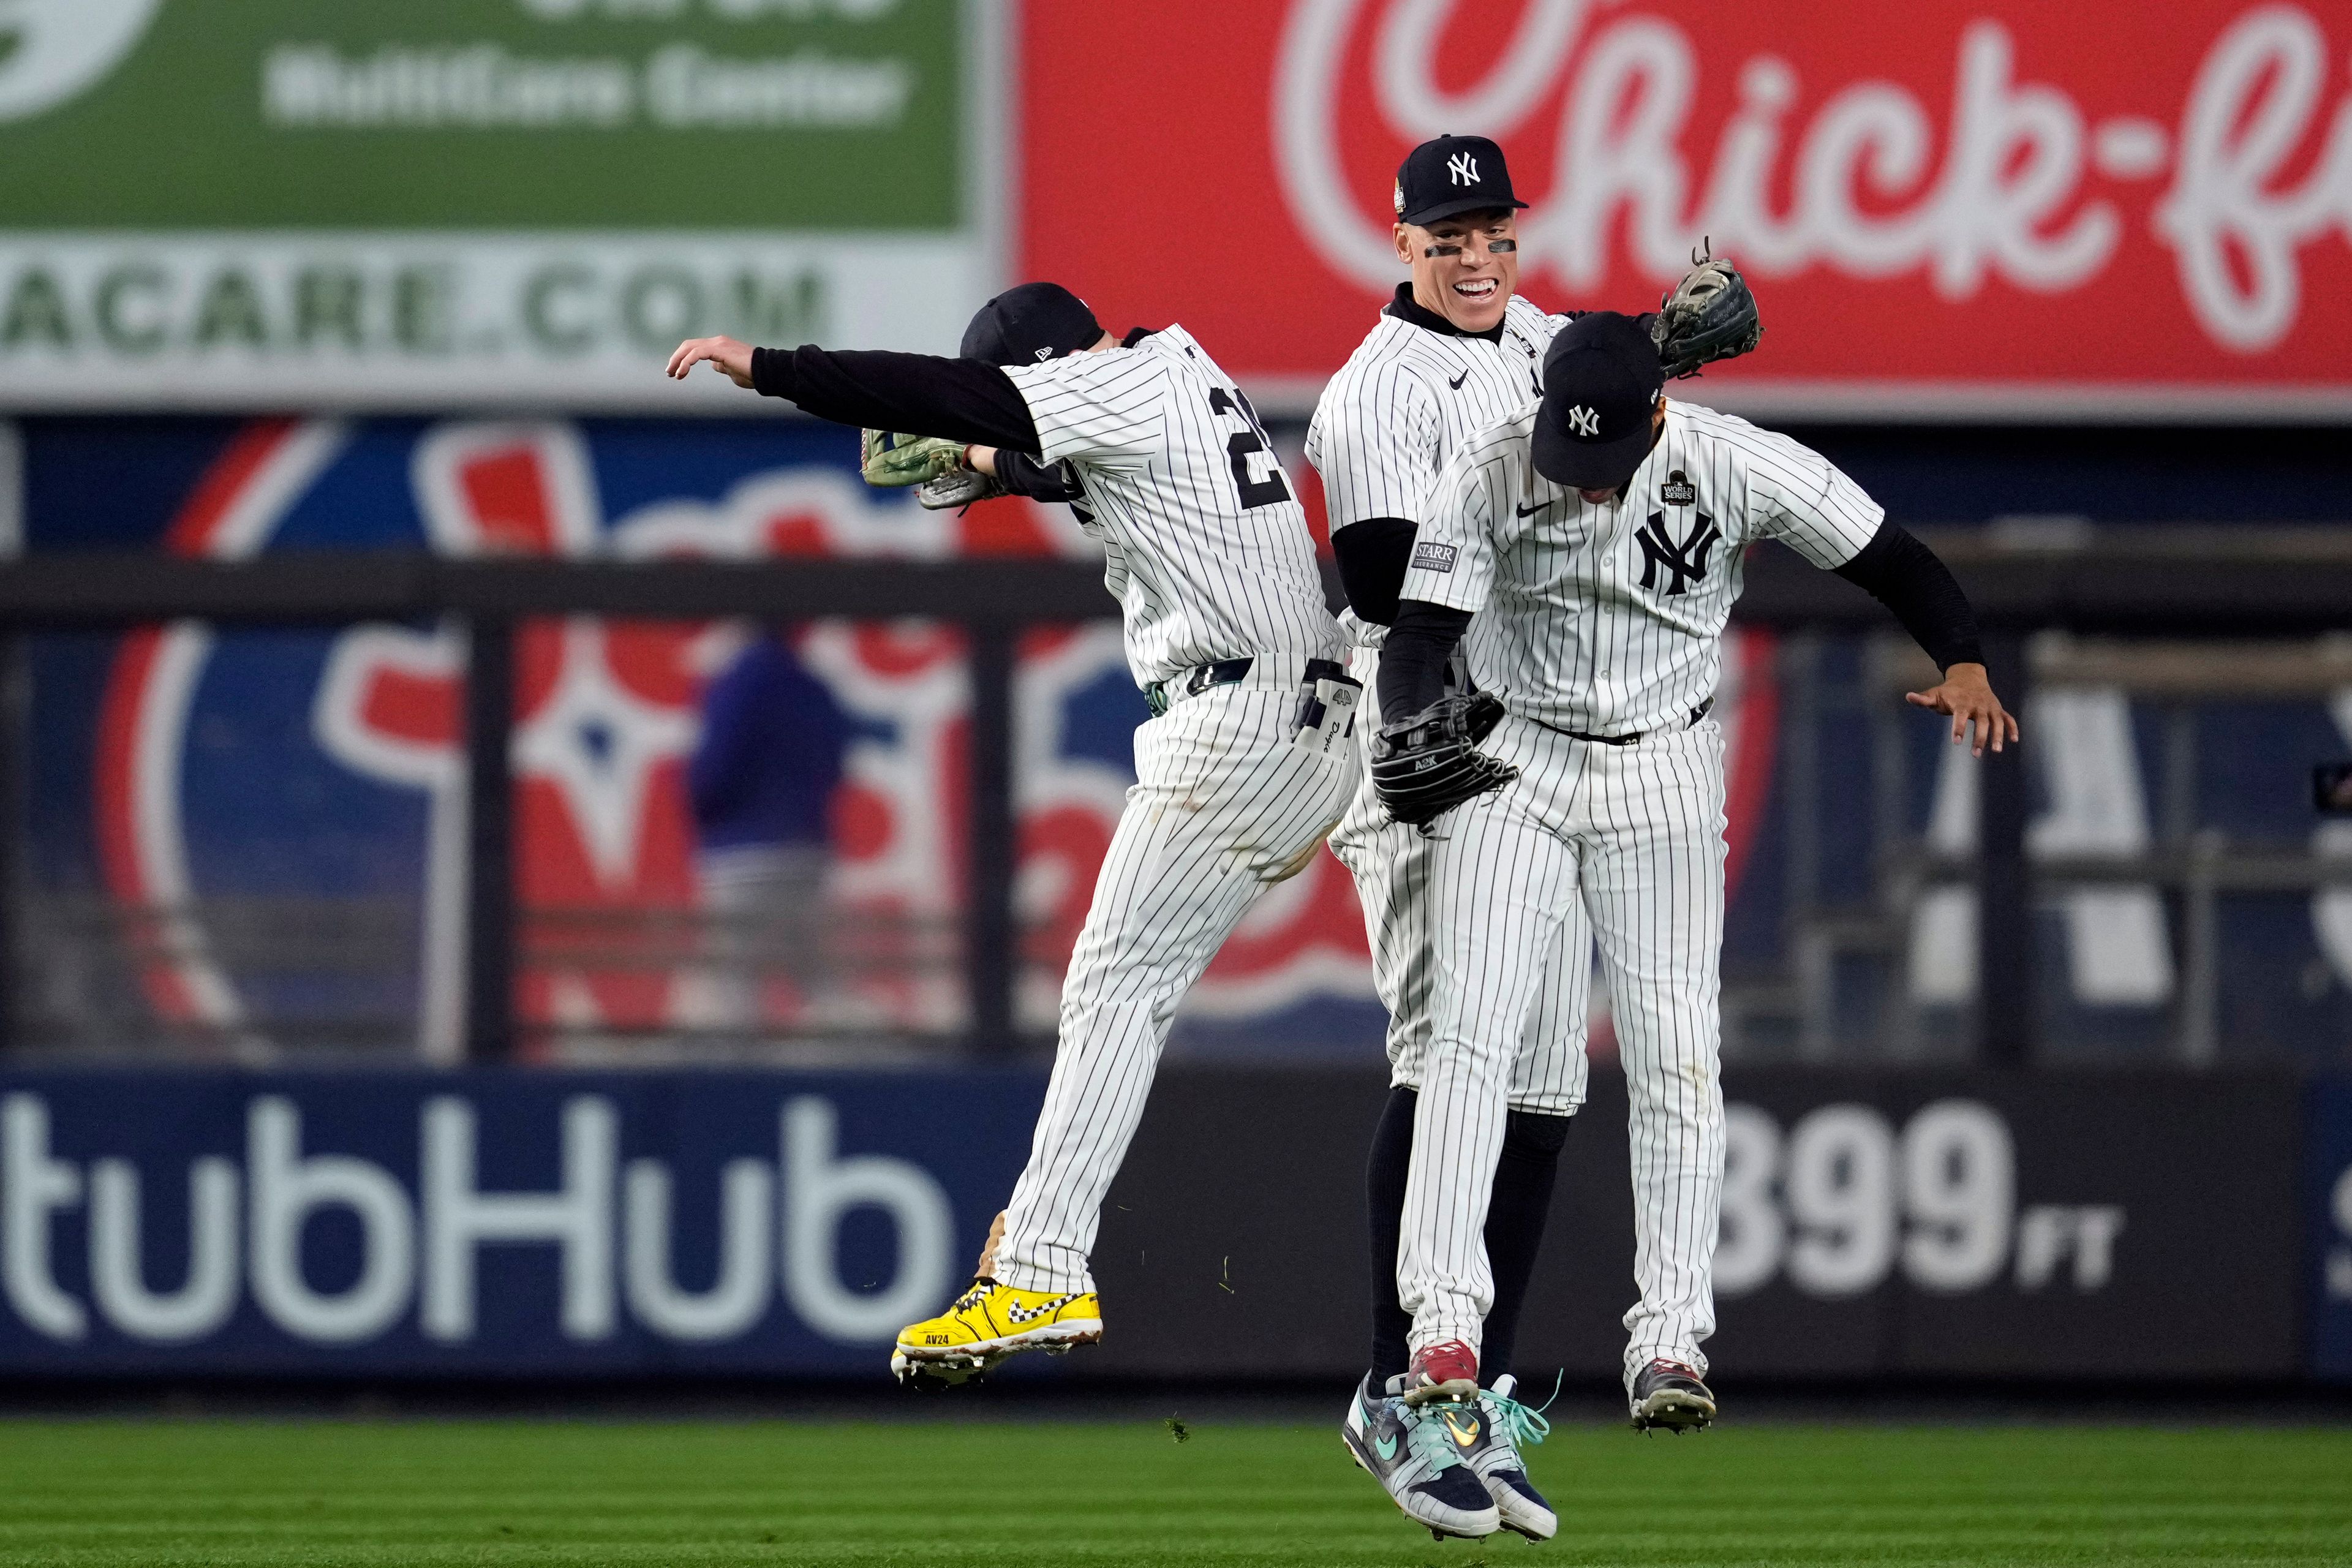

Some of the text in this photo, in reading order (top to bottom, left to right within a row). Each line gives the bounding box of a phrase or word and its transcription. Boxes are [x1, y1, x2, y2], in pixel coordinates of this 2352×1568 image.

[646, 45, 908, 126] Center
[1414, 560, 1449, 571] INSURANCE
[1416, 544, 1452, 561] STARR
[0, 1093, 957, 1344] tubHub
[1711, 1100, 2127, 1294] 399 FT
[925, 1335, 949, 1345] AV24
